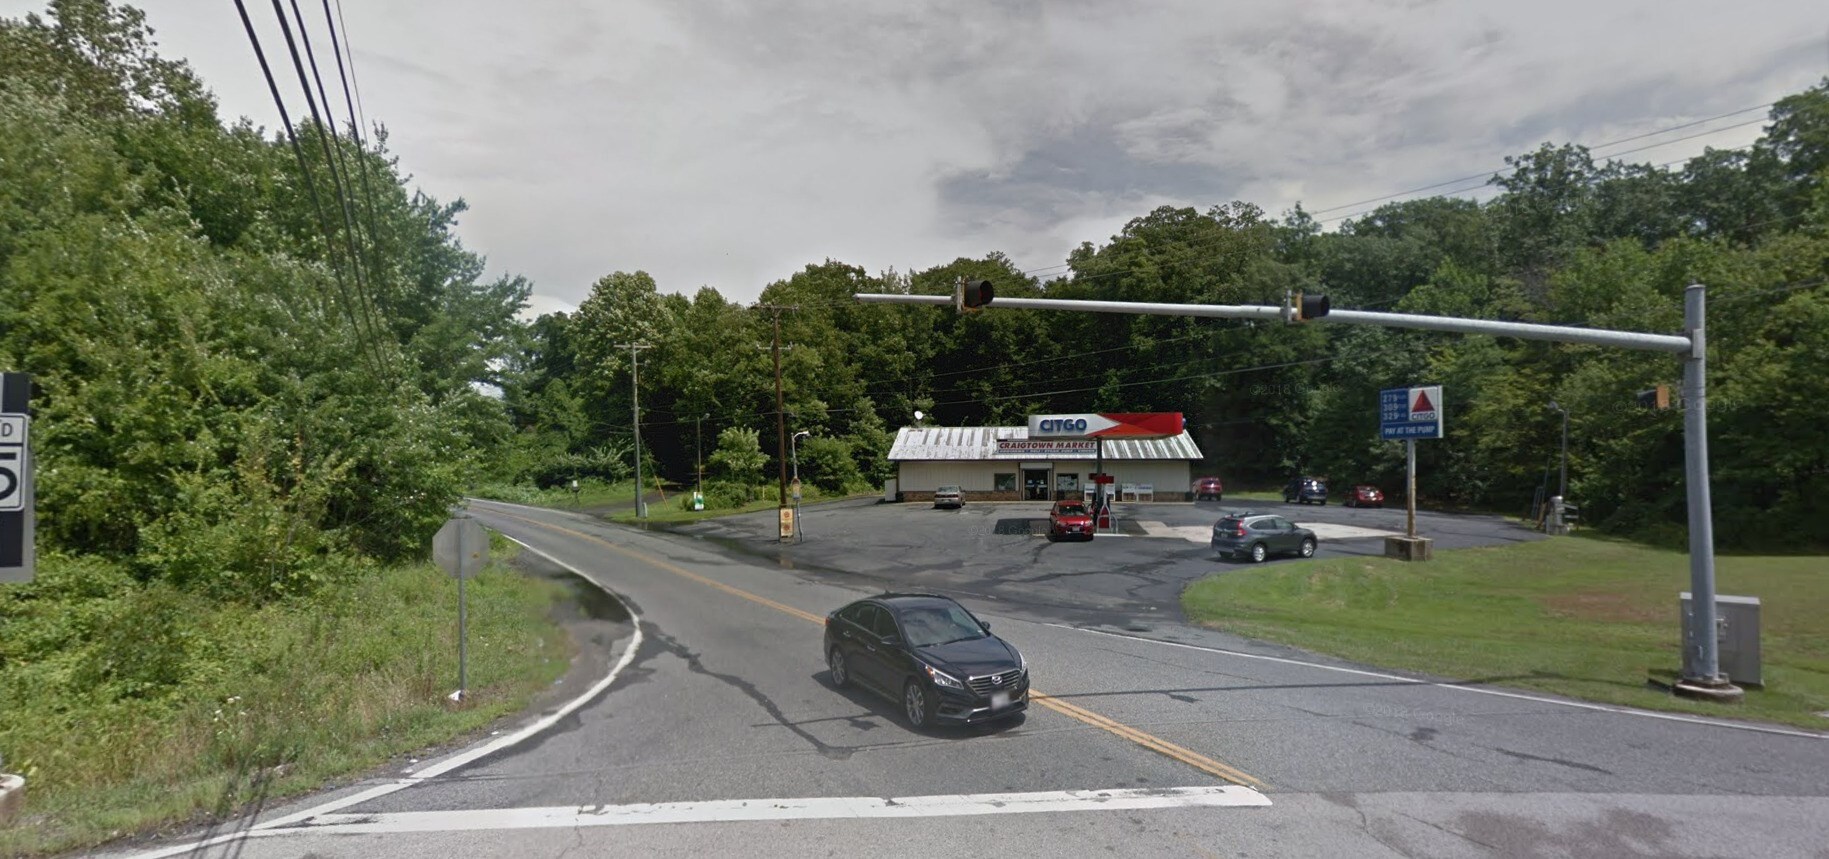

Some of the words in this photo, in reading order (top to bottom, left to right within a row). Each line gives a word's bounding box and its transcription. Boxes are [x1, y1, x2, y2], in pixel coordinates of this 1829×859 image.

[1412, 412, 1435, 420] CITGO
[1039, 418, 1087, 432] CITGO
[1405, 426, 1417, 434] THE
